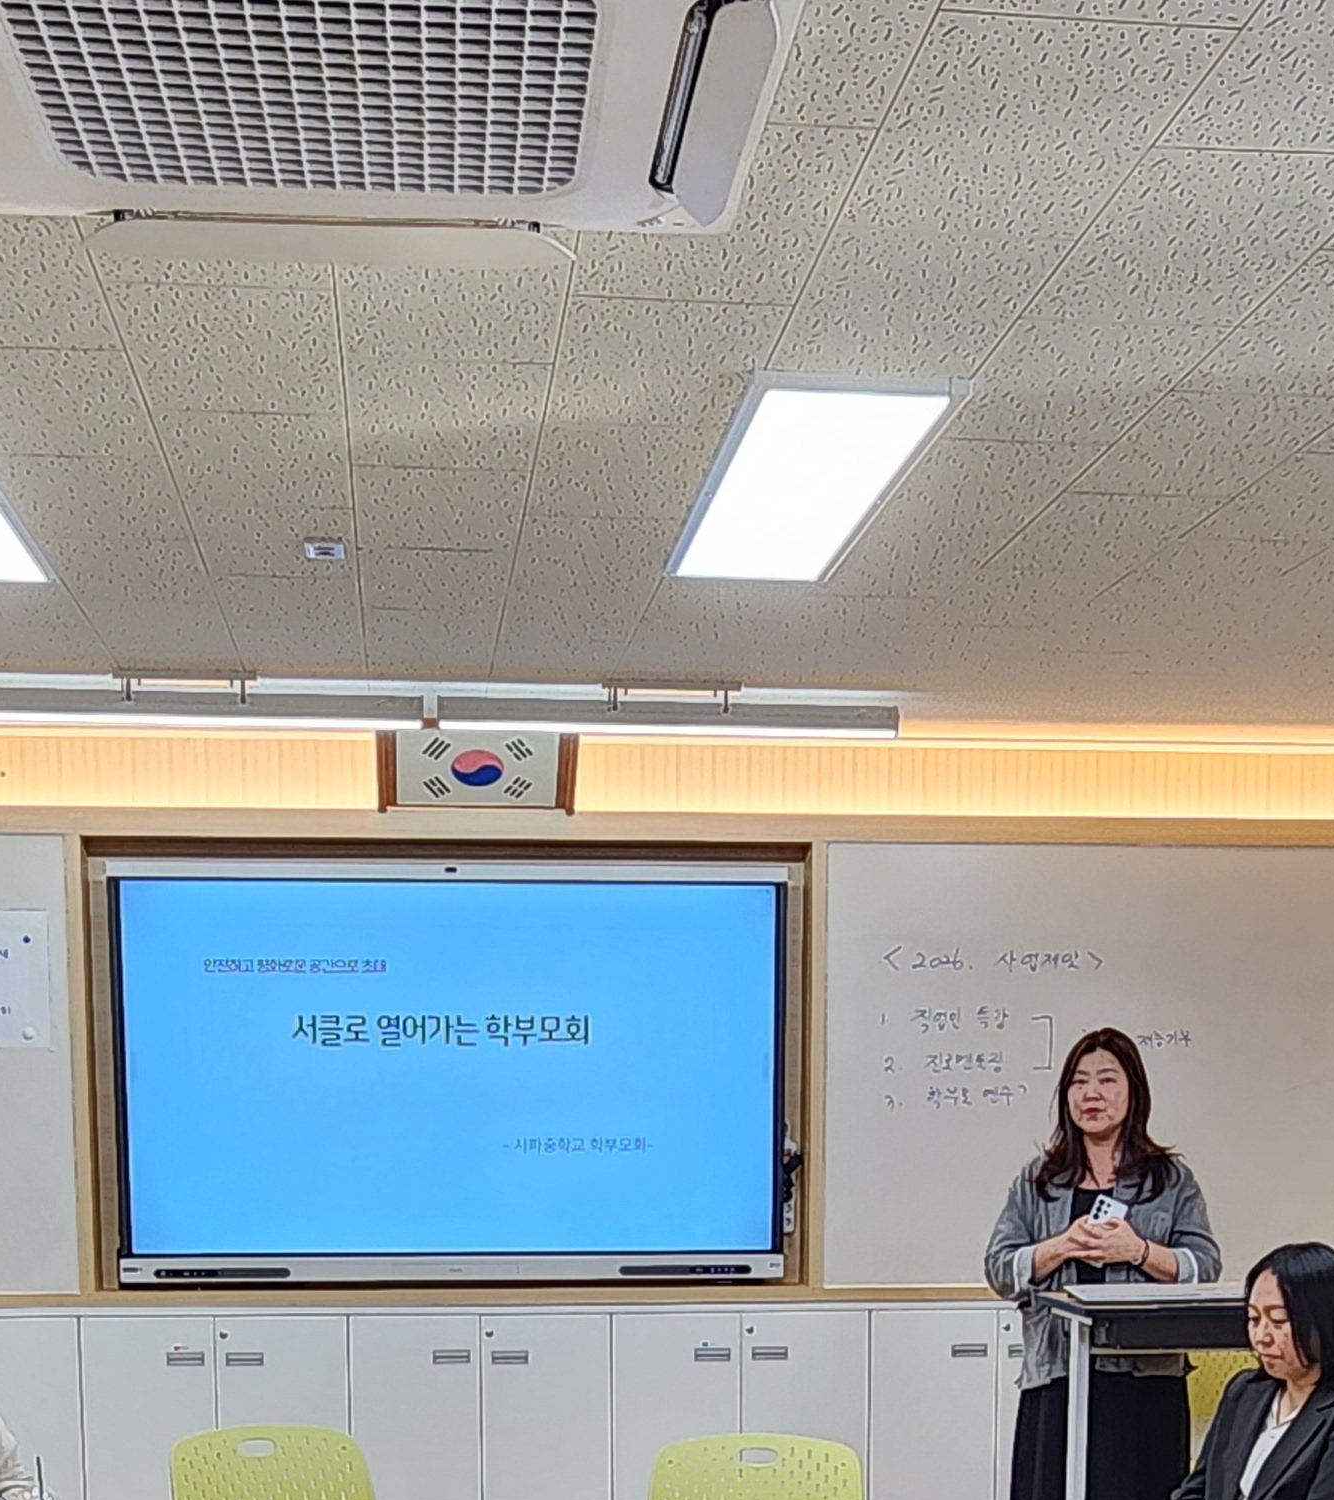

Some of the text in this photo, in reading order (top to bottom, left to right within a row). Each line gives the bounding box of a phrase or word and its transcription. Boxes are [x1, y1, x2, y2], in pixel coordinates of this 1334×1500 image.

[309, 958, 359, 973] 공간으로
[291, 1014, 589, 1047] 서클로 열어가는 학부모회
[910, 1007, 961, 1034] 직업인
[976, 1006, 1009, 1030] 특강
[927, 1086, 971, 1109] 학부모
